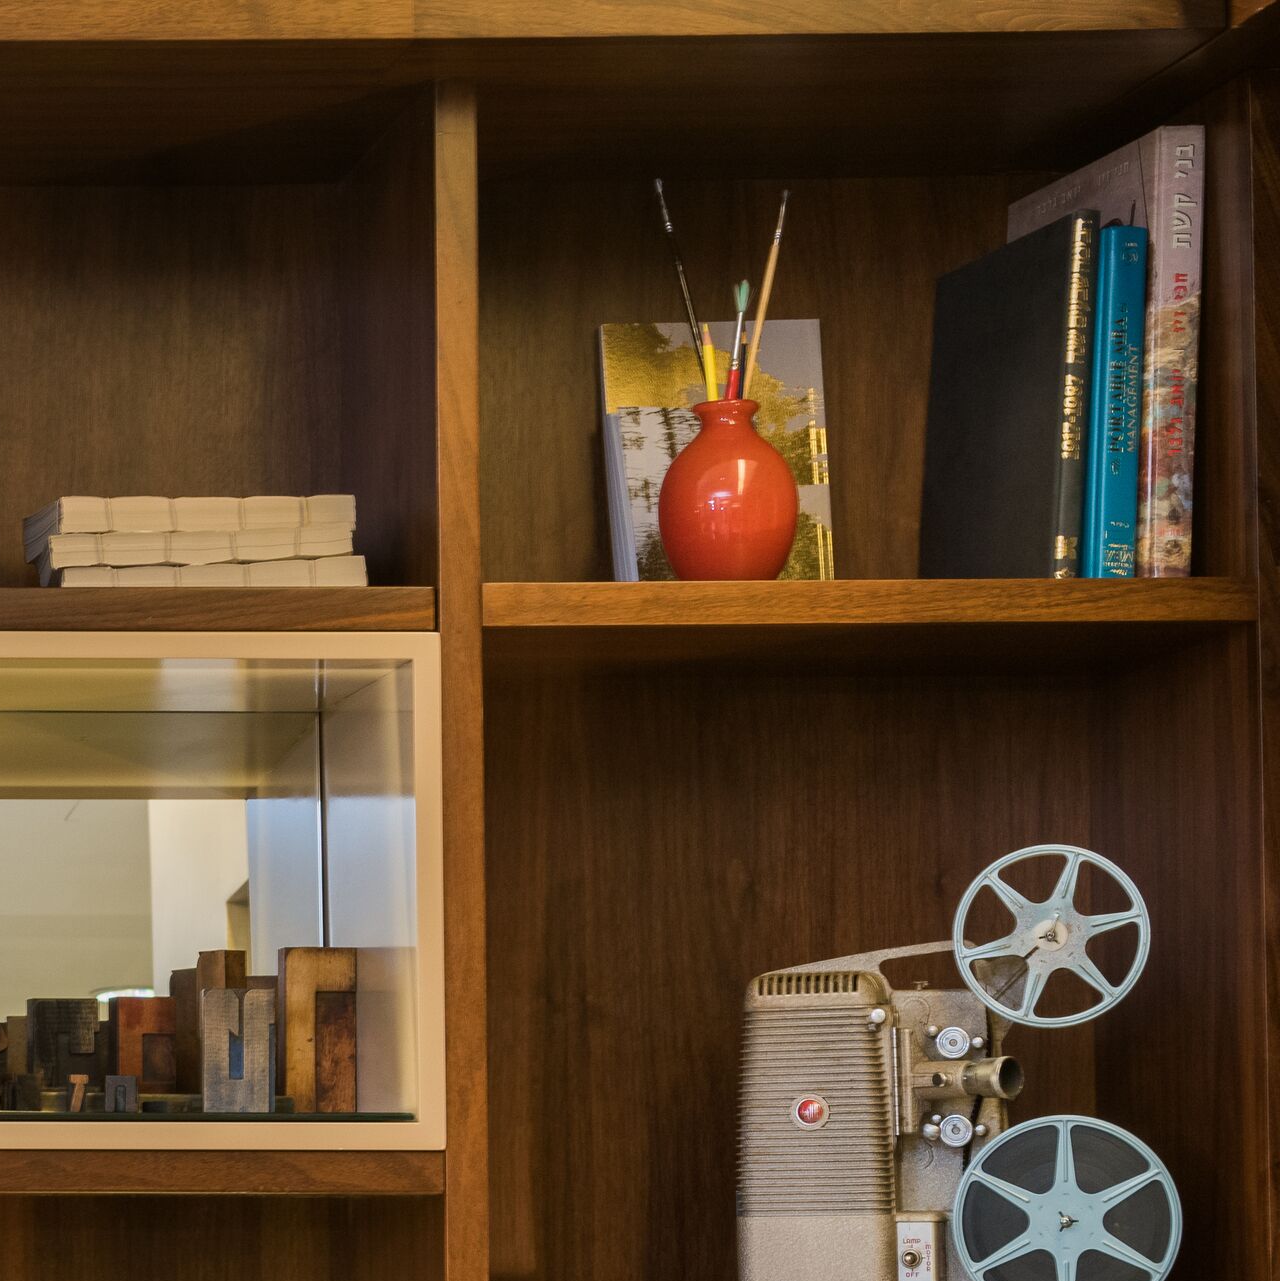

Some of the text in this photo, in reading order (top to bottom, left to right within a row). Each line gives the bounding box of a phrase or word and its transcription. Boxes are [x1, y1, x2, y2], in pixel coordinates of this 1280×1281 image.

[1172, 143, 1198, 249] בני קשת
[1126, 343, 1140, 454] MANAGEMENT
